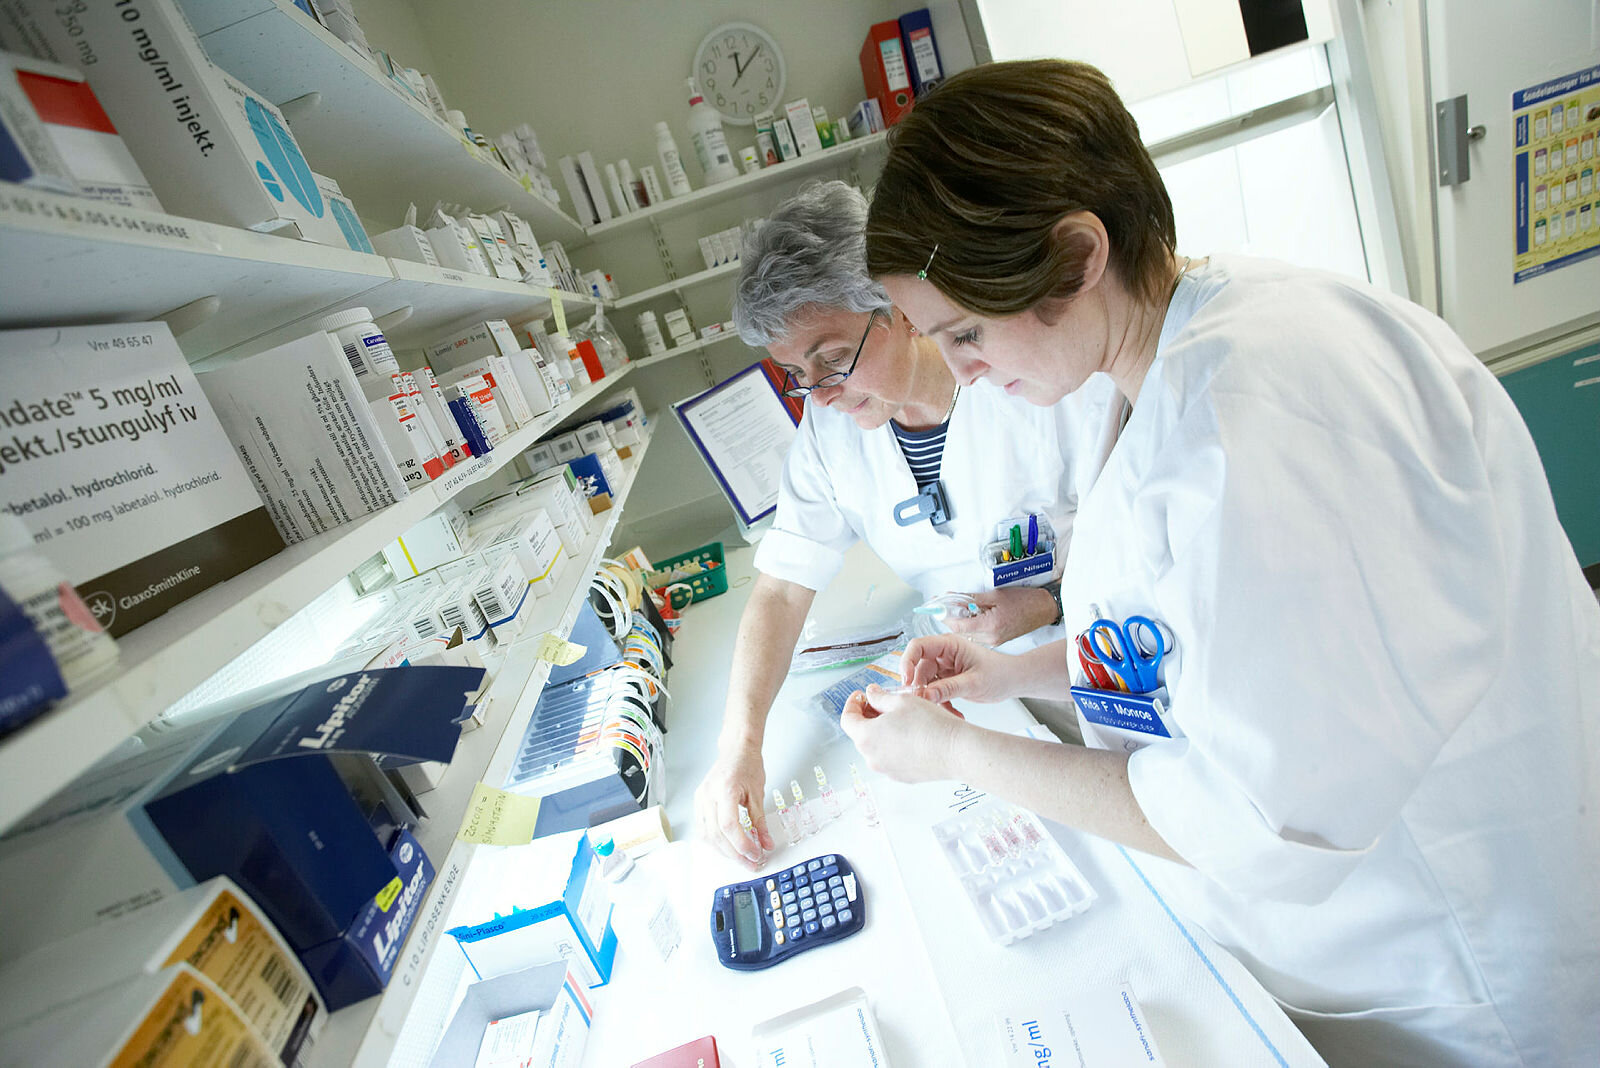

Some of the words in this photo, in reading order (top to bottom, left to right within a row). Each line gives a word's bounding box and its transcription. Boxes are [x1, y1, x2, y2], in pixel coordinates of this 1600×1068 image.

[76, 40, 98, 65] mg
[131, 28, 183, 92] mg/ml
[172, 96, 215, 157] injekt.
[140, 220, 190, 240] DIVERSE
[88, 339, 109, 354] Vnr
[112, 337, 126, 351] 49
[127, 336, 141, 349] 65
[141, 334, 154, 347] 47
[88, 388, 109, 410] 5
[112, 374, 183, 409] mg/ml
[175, 402, 199, 422] iv
[404, 457, 416, 468] 28
[3, 488, 72, 516] betalol.
[72, 462, 159, 498] hydrochlorid.
[33, 527, 53, 544] ml
[66, 515, 91, 531] 100
[92, 508, 114, 522] mg
[113, 490, 163, 515] labetalol.
[164, 470, 222, 501] hydrochlorid.
[119, 565, 201, 610] GlaxoSmithKline
[997, 569, 1019, 581] Anne
[299, 674, 370, 748] Lipitor
[1080, 697, 1100, 711] Rita
[1116, 701, 1153, 721] Monroe
[463, 806, 485, 838] ZOCOR
[372, 859, 425, 966] Lipitor
[418, 864, 460, 951] LIPIDSENKENDE
